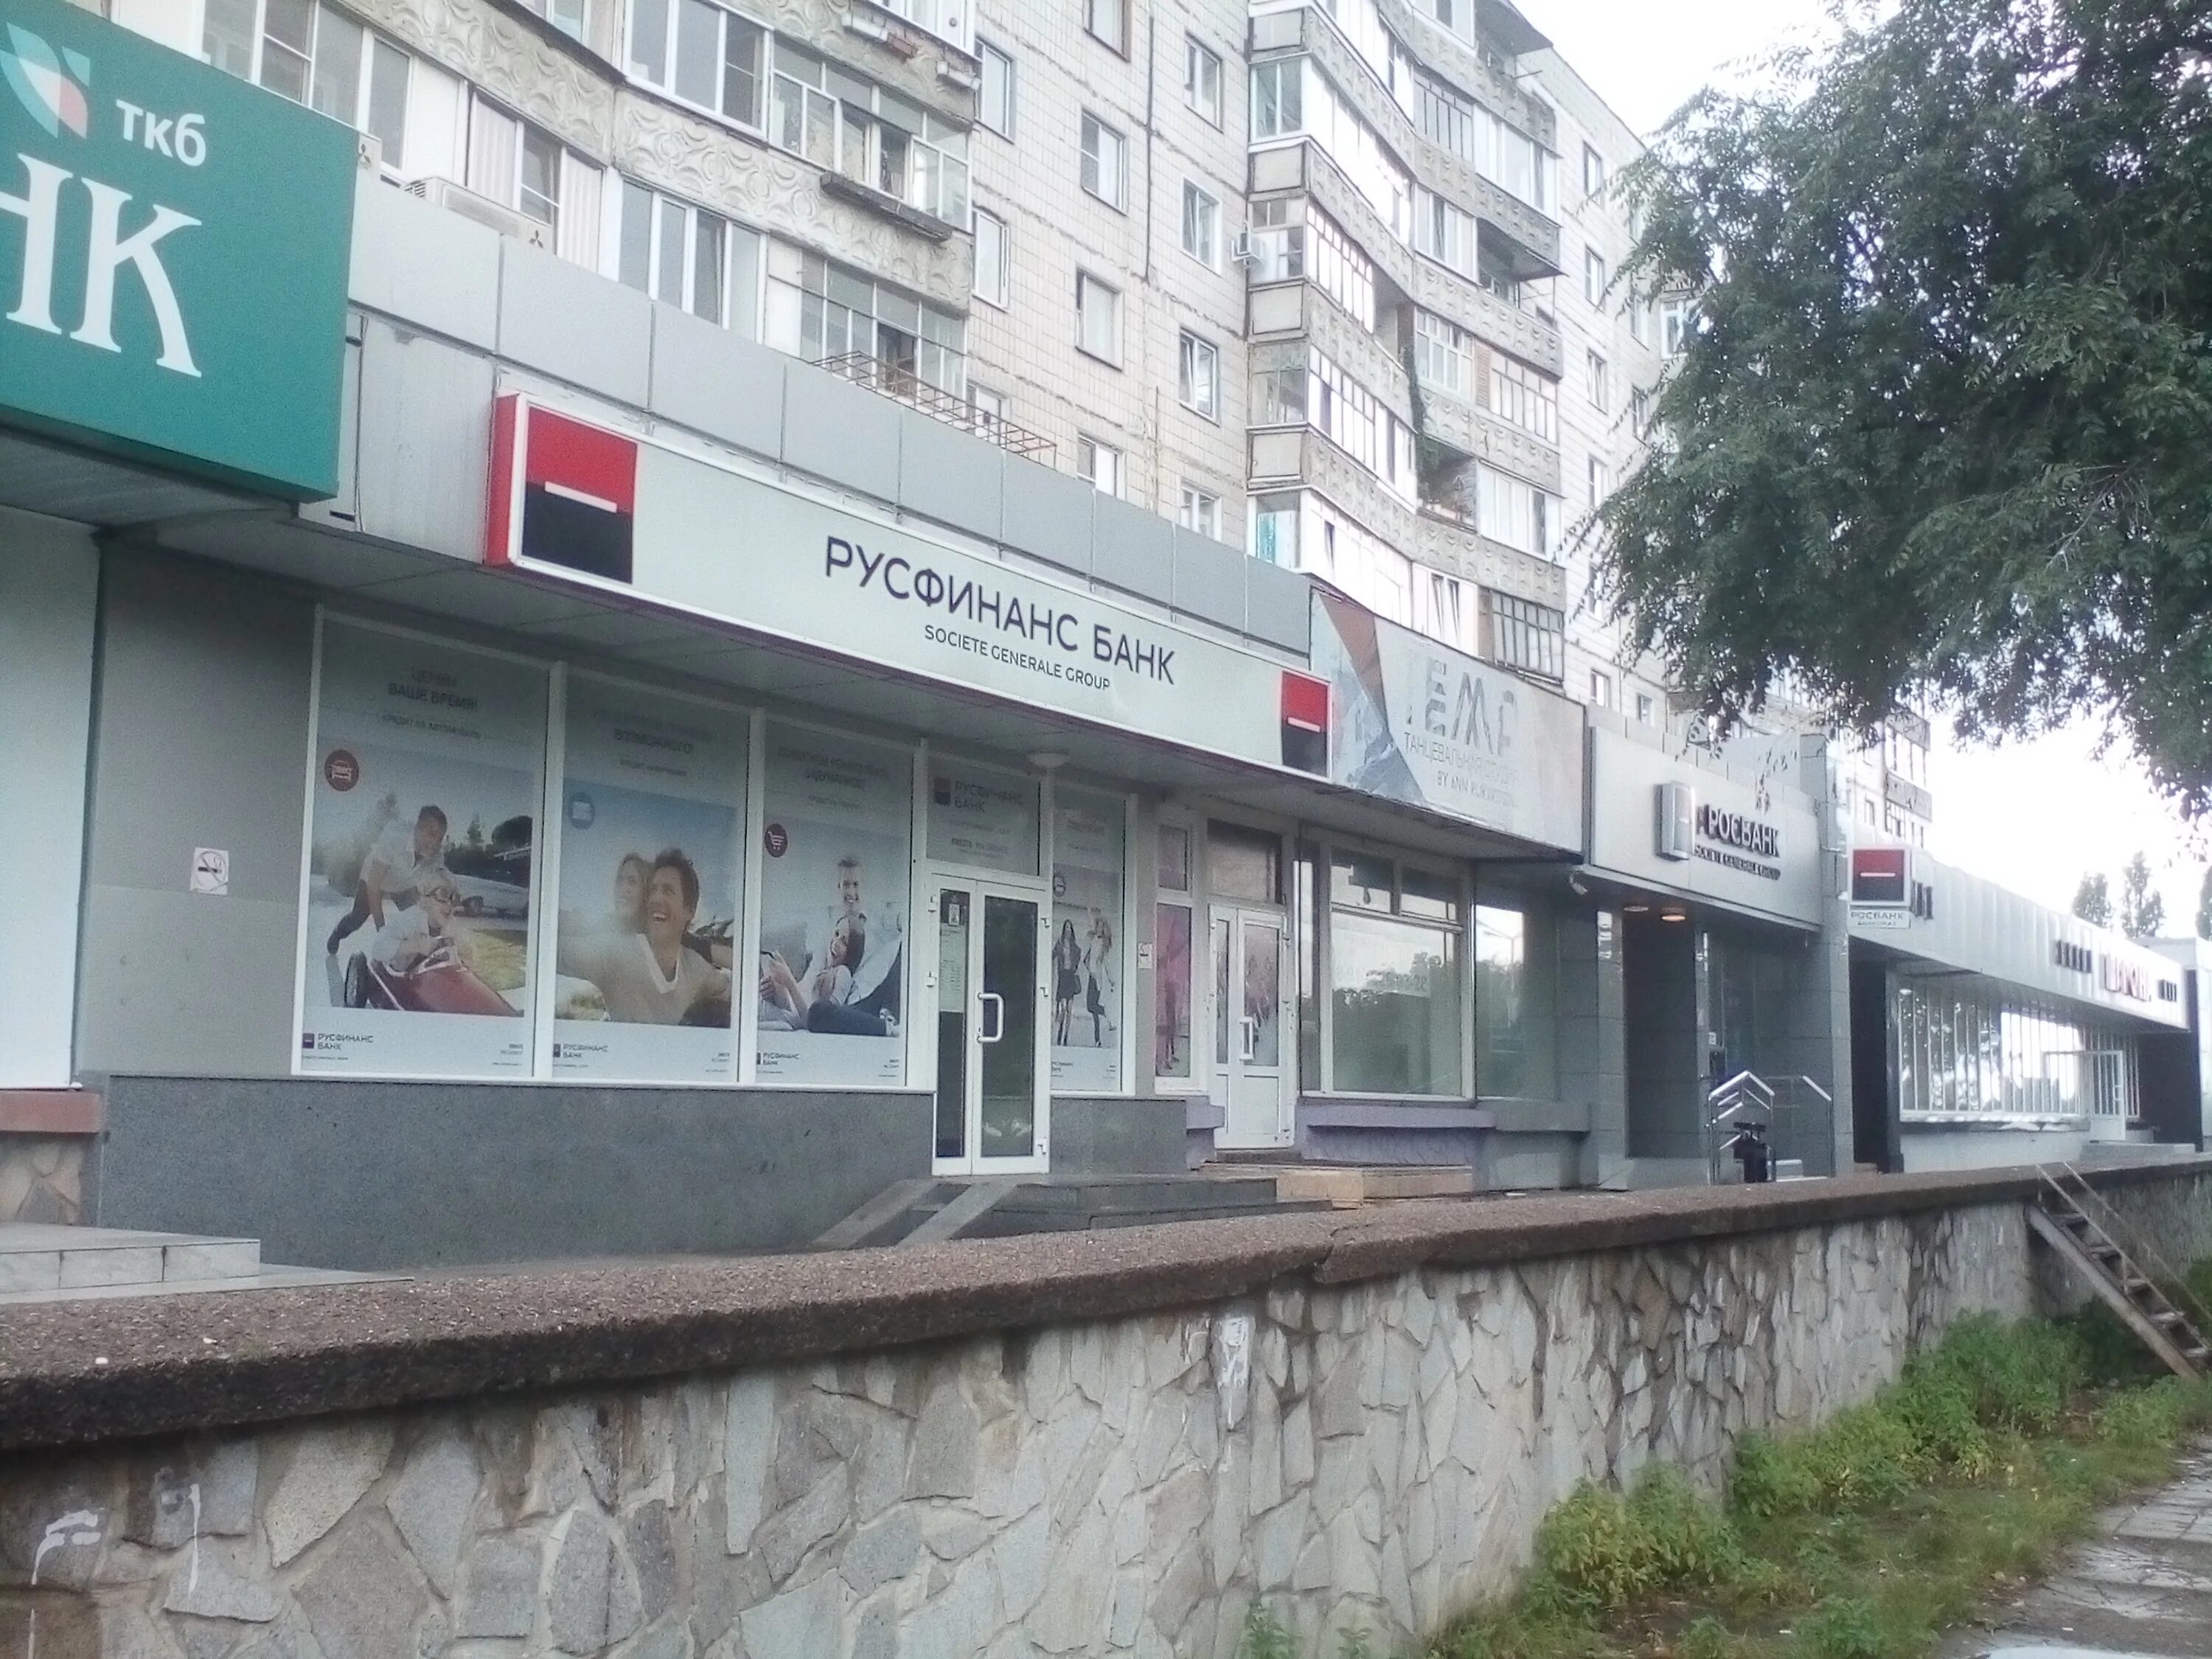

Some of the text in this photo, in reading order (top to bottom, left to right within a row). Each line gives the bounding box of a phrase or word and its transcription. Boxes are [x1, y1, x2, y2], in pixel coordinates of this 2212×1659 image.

[116, 99, 206, 167] ткб
[825, 535, 1176, 684] РУСФИНАНС БАНК
[925, 625, 1110, 692] SOCIETE GENERALE GROUP
[1704, 805, 1781, 858] РОСБАНК
[1851, 911, 1904, 920] РОСБАНК
[318, 1033, 374, 1043] РУСФИНАНС
[318, 1043, 341, 1051] БАНК
